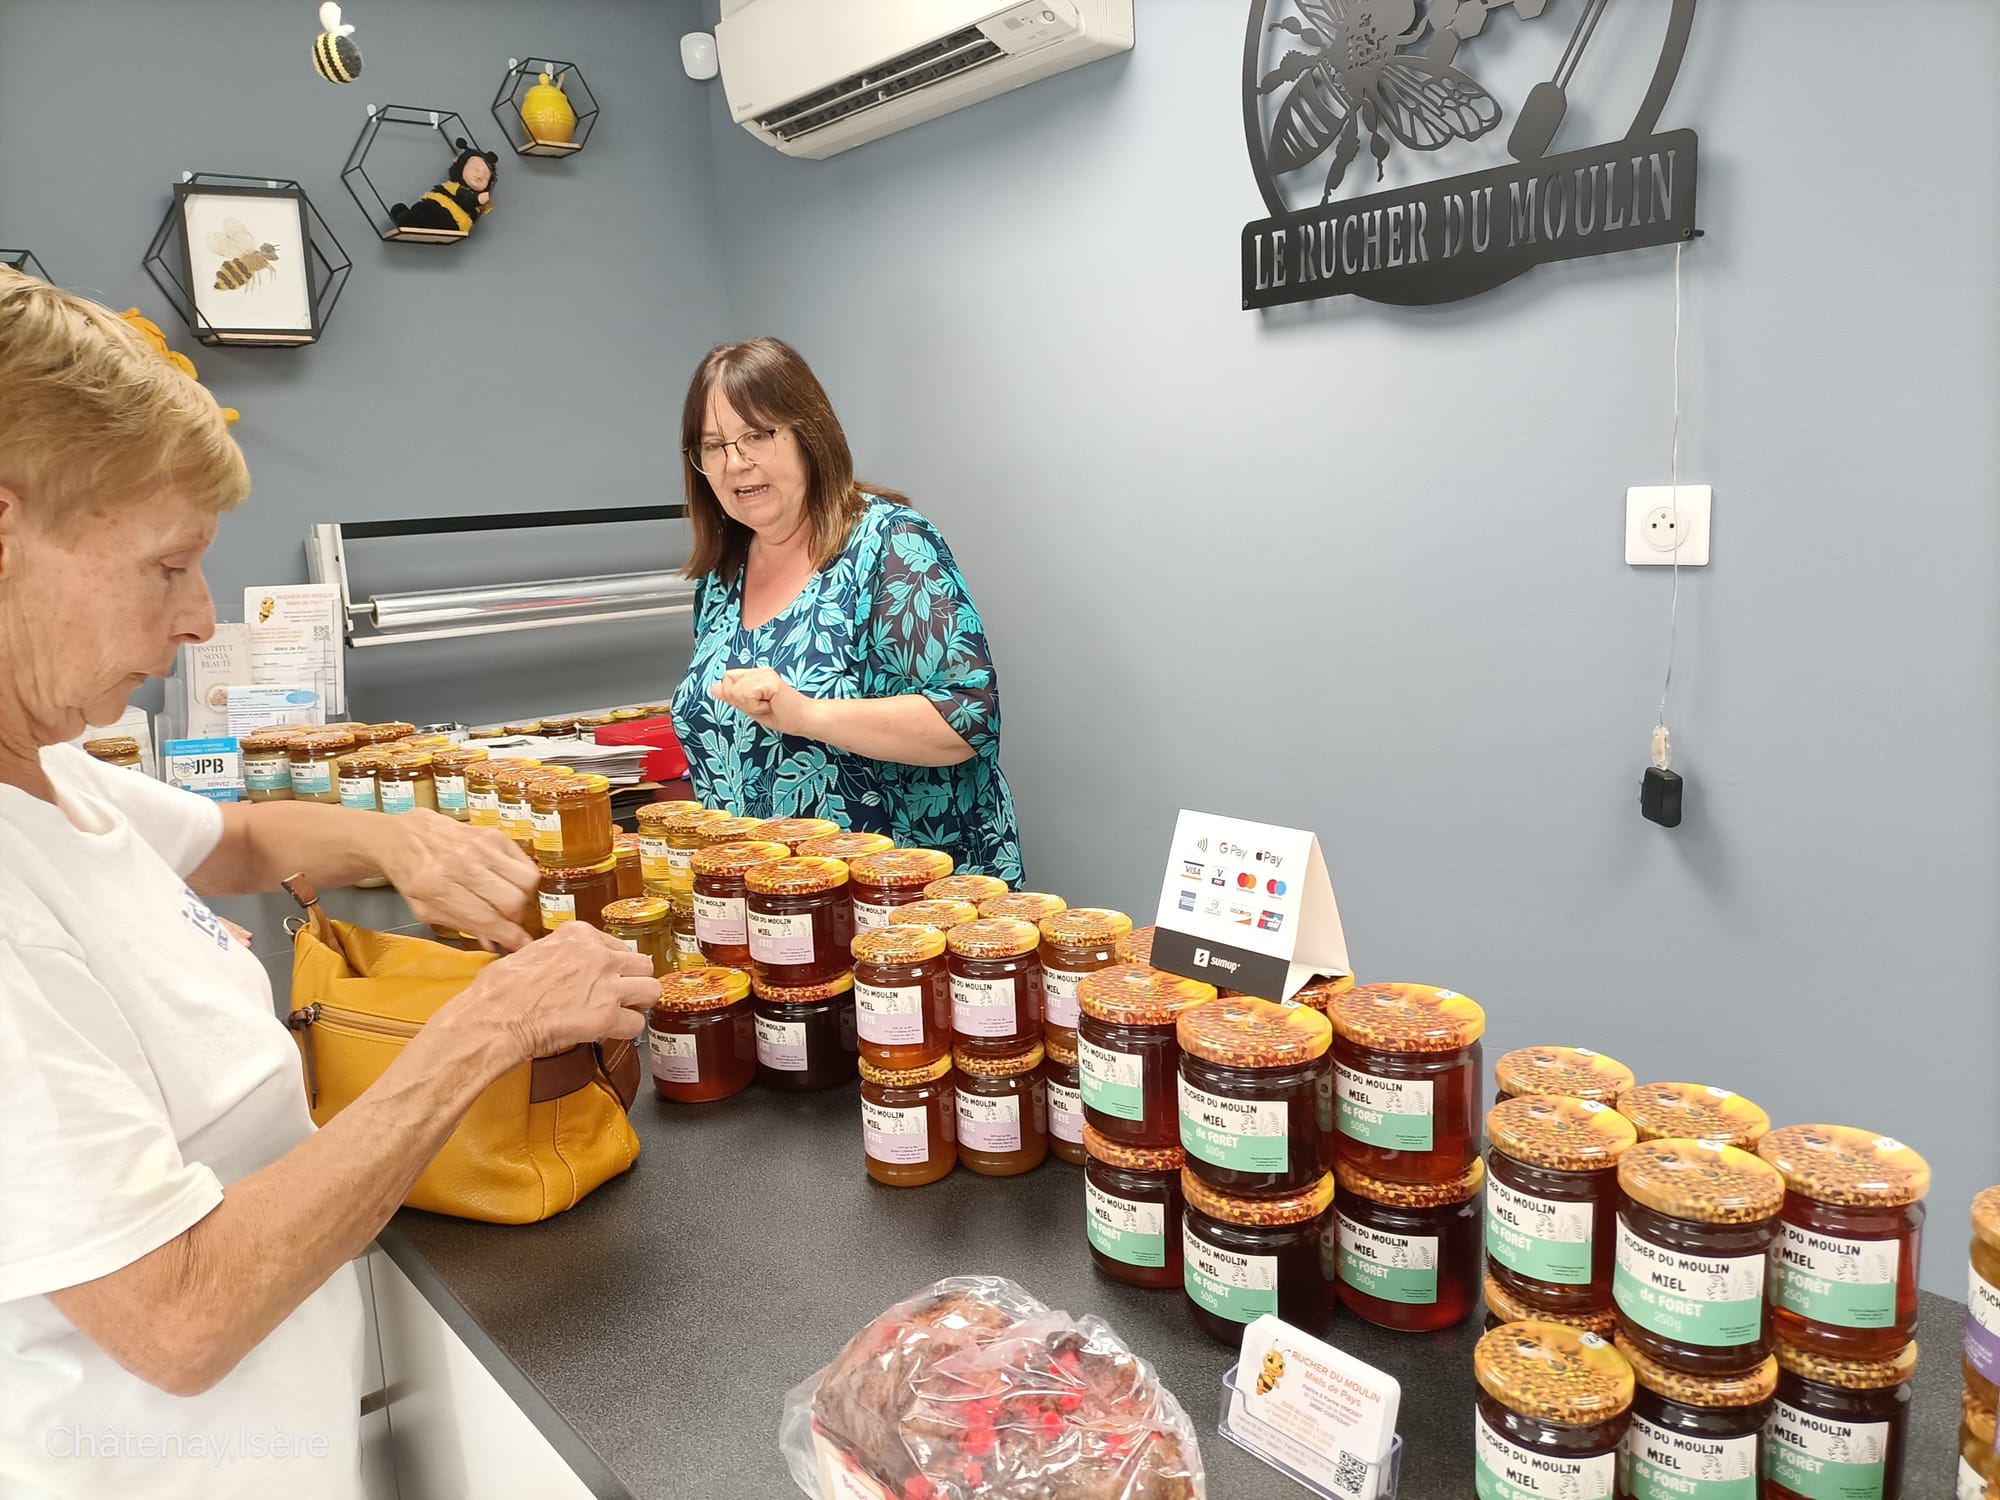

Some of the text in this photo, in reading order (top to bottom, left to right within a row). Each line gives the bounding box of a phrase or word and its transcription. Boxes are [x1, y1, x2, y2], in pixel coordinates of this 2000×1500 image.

[1254, 150, 1677, 291] LE RUCHER DU MOULIN
[194, 758, 224, 775] JPB
[1219, 842, 1248, 860] G Pay
[1263, 851, 1283, 868] Pay
[1185, 865, 1201, 876] VISA
[1210, 956, 1238, 973] sumup
[871, 991, 899, 999] MOULIN
[965, 982, 993, 991] MOULIN
[1046, 983, 1061, 995] MIEL
[860, 1000, 875, 1012] MIEL
[954, 992, 969, 1004] MIEL
[1090, 1047, 1117, 1063] MOULIN
[1082, 1056, 1095, 1073] MIEL
[1353, 1074, 1364, 1085] DU
[1366, 1078, 1403, 1092] MOULIN
[970, 1098, 997, 1108] MOULIN
[1053, 1099, 1069, 1111] MIEL
[1207, 1097, 1218, 1108] DU
[1220, 1101, 1258, 1114] MOULIN
[1348, 1088, 1372, 1105] MIEL
[877, 1109, 905, 1119] MOULIN
[960, 1106, 975, 1119] MIEL
[1203, 1112, 1227, 1128] MIEL
[1342, 1102, 1384, 1125] de FORÊT
[867, 1118, 881, 1131] MIEL
[1195, 1126, 1206, 1140] de
[1350, 1120, 1370, 1137] 500g
[1204, 1143, 1225, 1161] 500g
[1097, 1193, 1137, 1213] DU MOULIN
[1500, 1189, 1556, 1215] DU MOULIN
[1095, 1206, 1112, 1222] MIEL
[1496, 1205, 1520, 1226] MIEL
[1358, 1228, 1369, 1239] DU
[1371, 1233, 1409, 1248] MOULIN
[1500, 1227, 1533, 1251] FORÊT
[1788, 1230, 1861, 1256] DU MOULIN
[1201, 1245, 1212, 1257] DU
[1213, 1251, 1248, 1267] MOULIN
[1354, 1242, 1378, 1259] MIEL
[1623, 1233, 1730, 1274] RUCHER DU MOULIN
[1782, 1247, 1815, 1270] MIEL
[1198, 1259, 1219, 1277] MIEL
[1346, 1254, 1390, 1280] de FORÊT
[1192, 1271, 1202, 1285] de
[1355, 1272, 1376, 1290] 500g
[1651, 1271, 1687, 1292] MIEL
[1787, 1271, 1833, 1296] FORÊT
[1200, 1289, 1218, 1308] 500g
[1639, 1287, 1704, 1318] de FORÊT
[1783, 1286, 1810, 1308] 250g
[1653, 1311, 1682, 1331] 250g
[1291, 1351, 1381, 1403] RUCHER DU MOULIN
[1304, 1370, 1362, 1407] Miels de Pays
[1781, 1408, 1852, 1438] DU MOULIN
[1654, 1430, 1670, 1445] DU
[1673, 1438, 1724, 1455] MOULIN
[1774, 1424, 1807, 1449] MIEL
[1512, 1450, 1528, 1465] DU
[1531, 1458, 1581, 1475] MOULIN
[1647, 1447, 1682, 1470] MIEL
[1779, 1447, 1824, 1474] FORÊT
[1506, 1467, 1540, 1490] MIEL
[1635, 1461, 1698, 1495] de FORÊT
[1775, 1461, 1802, 1485] 250g
[1495, 1481, 1510, 1499] de
